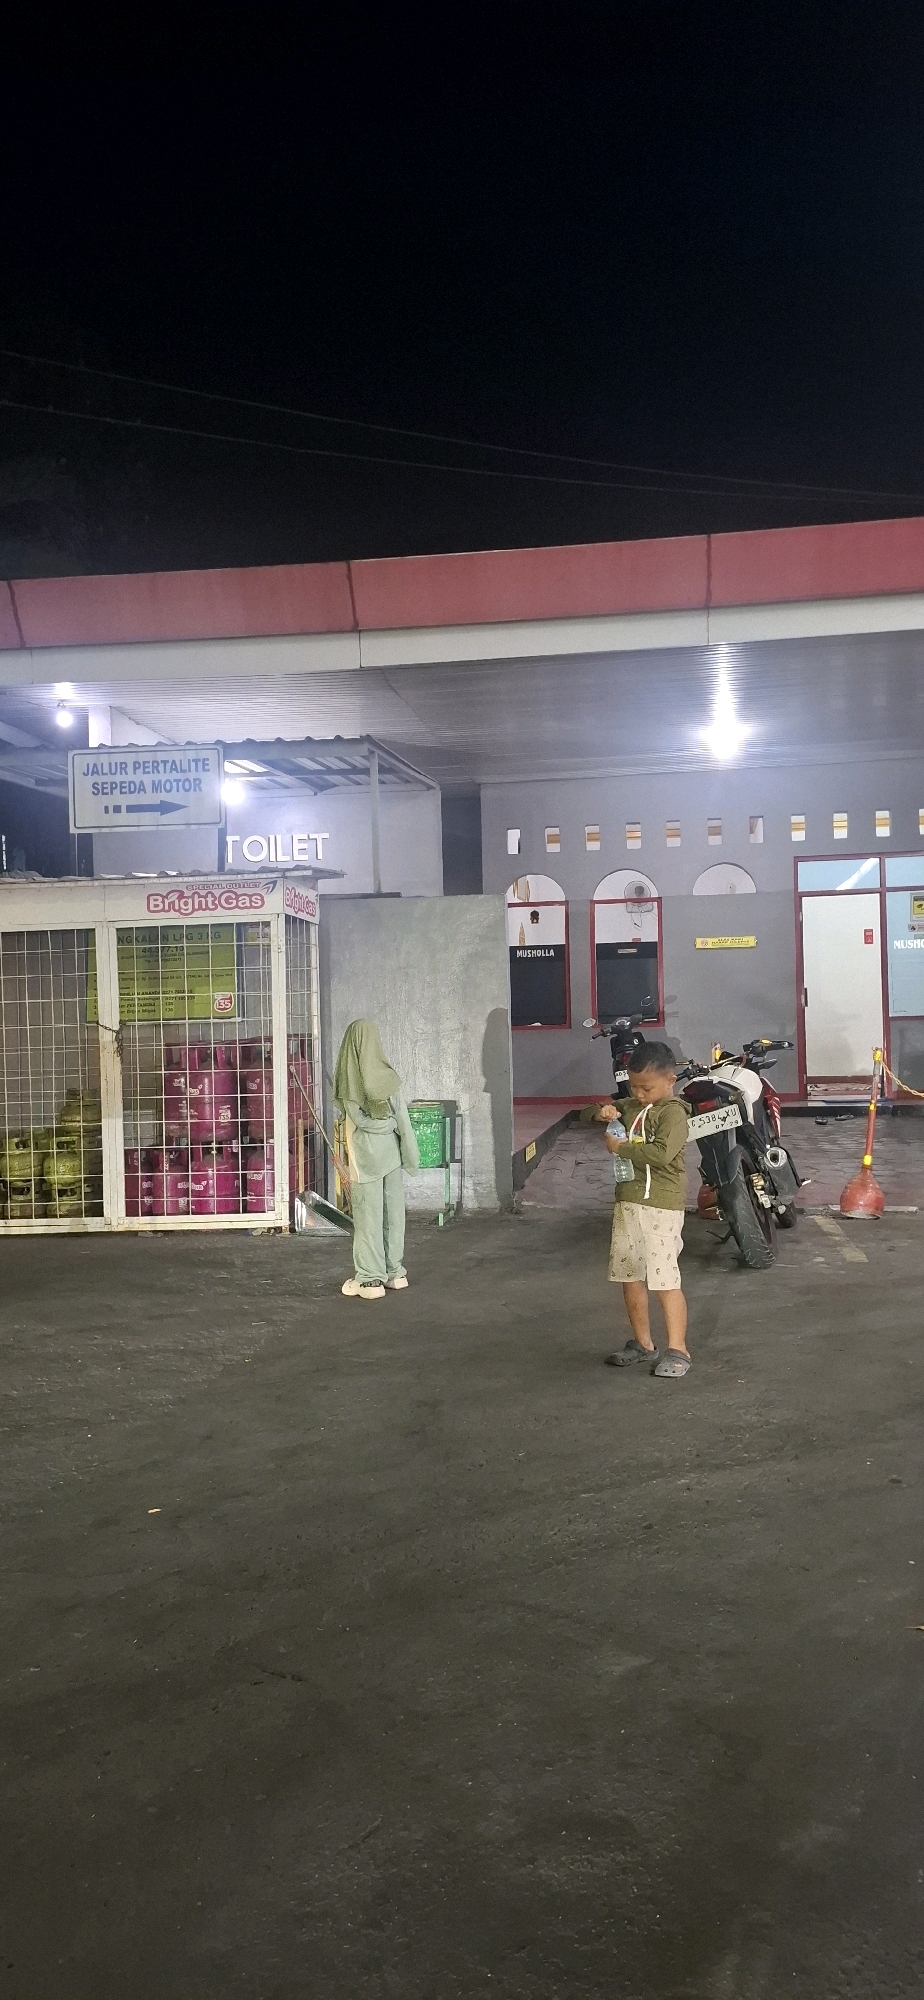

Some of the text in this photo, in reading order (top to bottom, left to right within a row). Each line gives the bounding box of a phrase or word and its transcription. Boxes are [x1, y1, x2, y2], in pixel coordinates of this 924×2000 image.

[82, 758, 211, 777] JALUR PERTALITE
[91, 777, 203, 796] SEPEDA MOTOR
[226, 832, 330, 864] TOILET
[186, 881, 262, 891] SPECIAL OUTLET
[147, 890, 265, 916] Bright Gas
[516, 949, 555, 958] MUSHOLLA
[216, 1000, 232, 1009] 135
